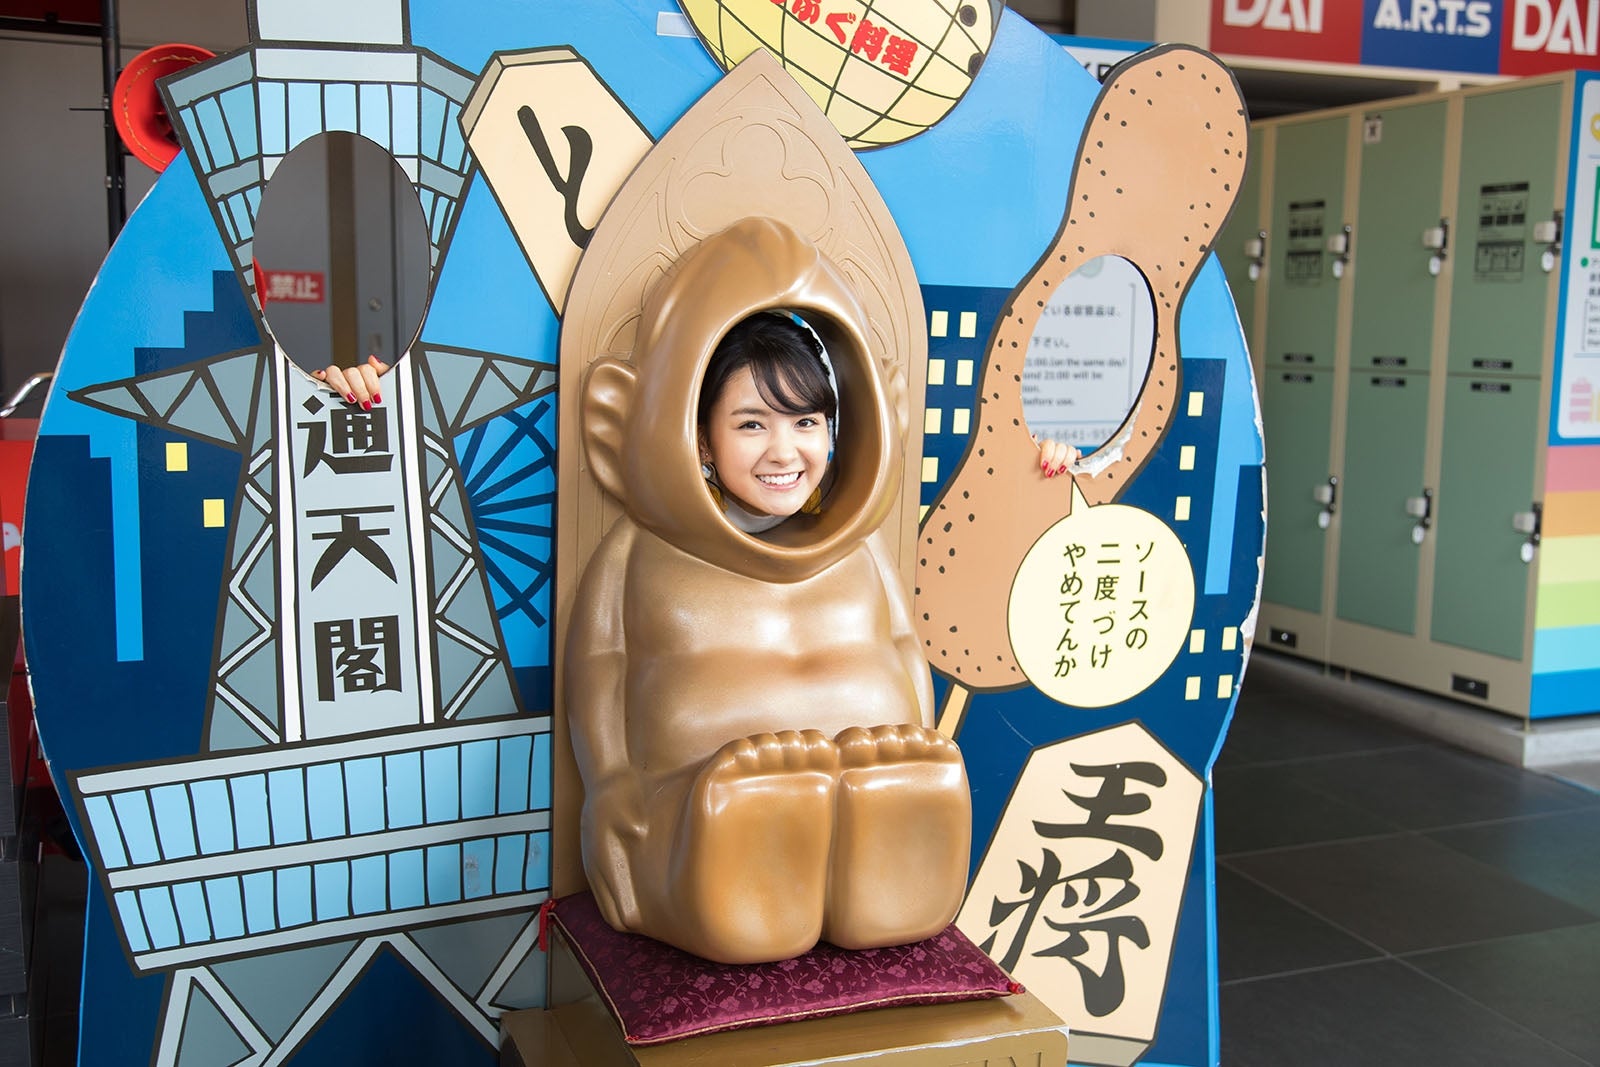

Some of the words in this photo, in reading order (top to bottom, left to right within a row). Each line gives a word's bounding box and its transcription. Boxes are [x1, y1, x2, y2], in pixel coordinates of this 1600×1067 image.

[768, 0, 918, 76] ふぐ料理
[266, 275, 319, 299] 禁止
[297, 391, 403, 703] 通天閣
[1091, 543, 1121, 669] 二度づけ
[1125, 541, 1155, 650] ソースの
[1054, 543, 1086, 678] やめてんか
[978, 761, 1168, 1018] 王将
